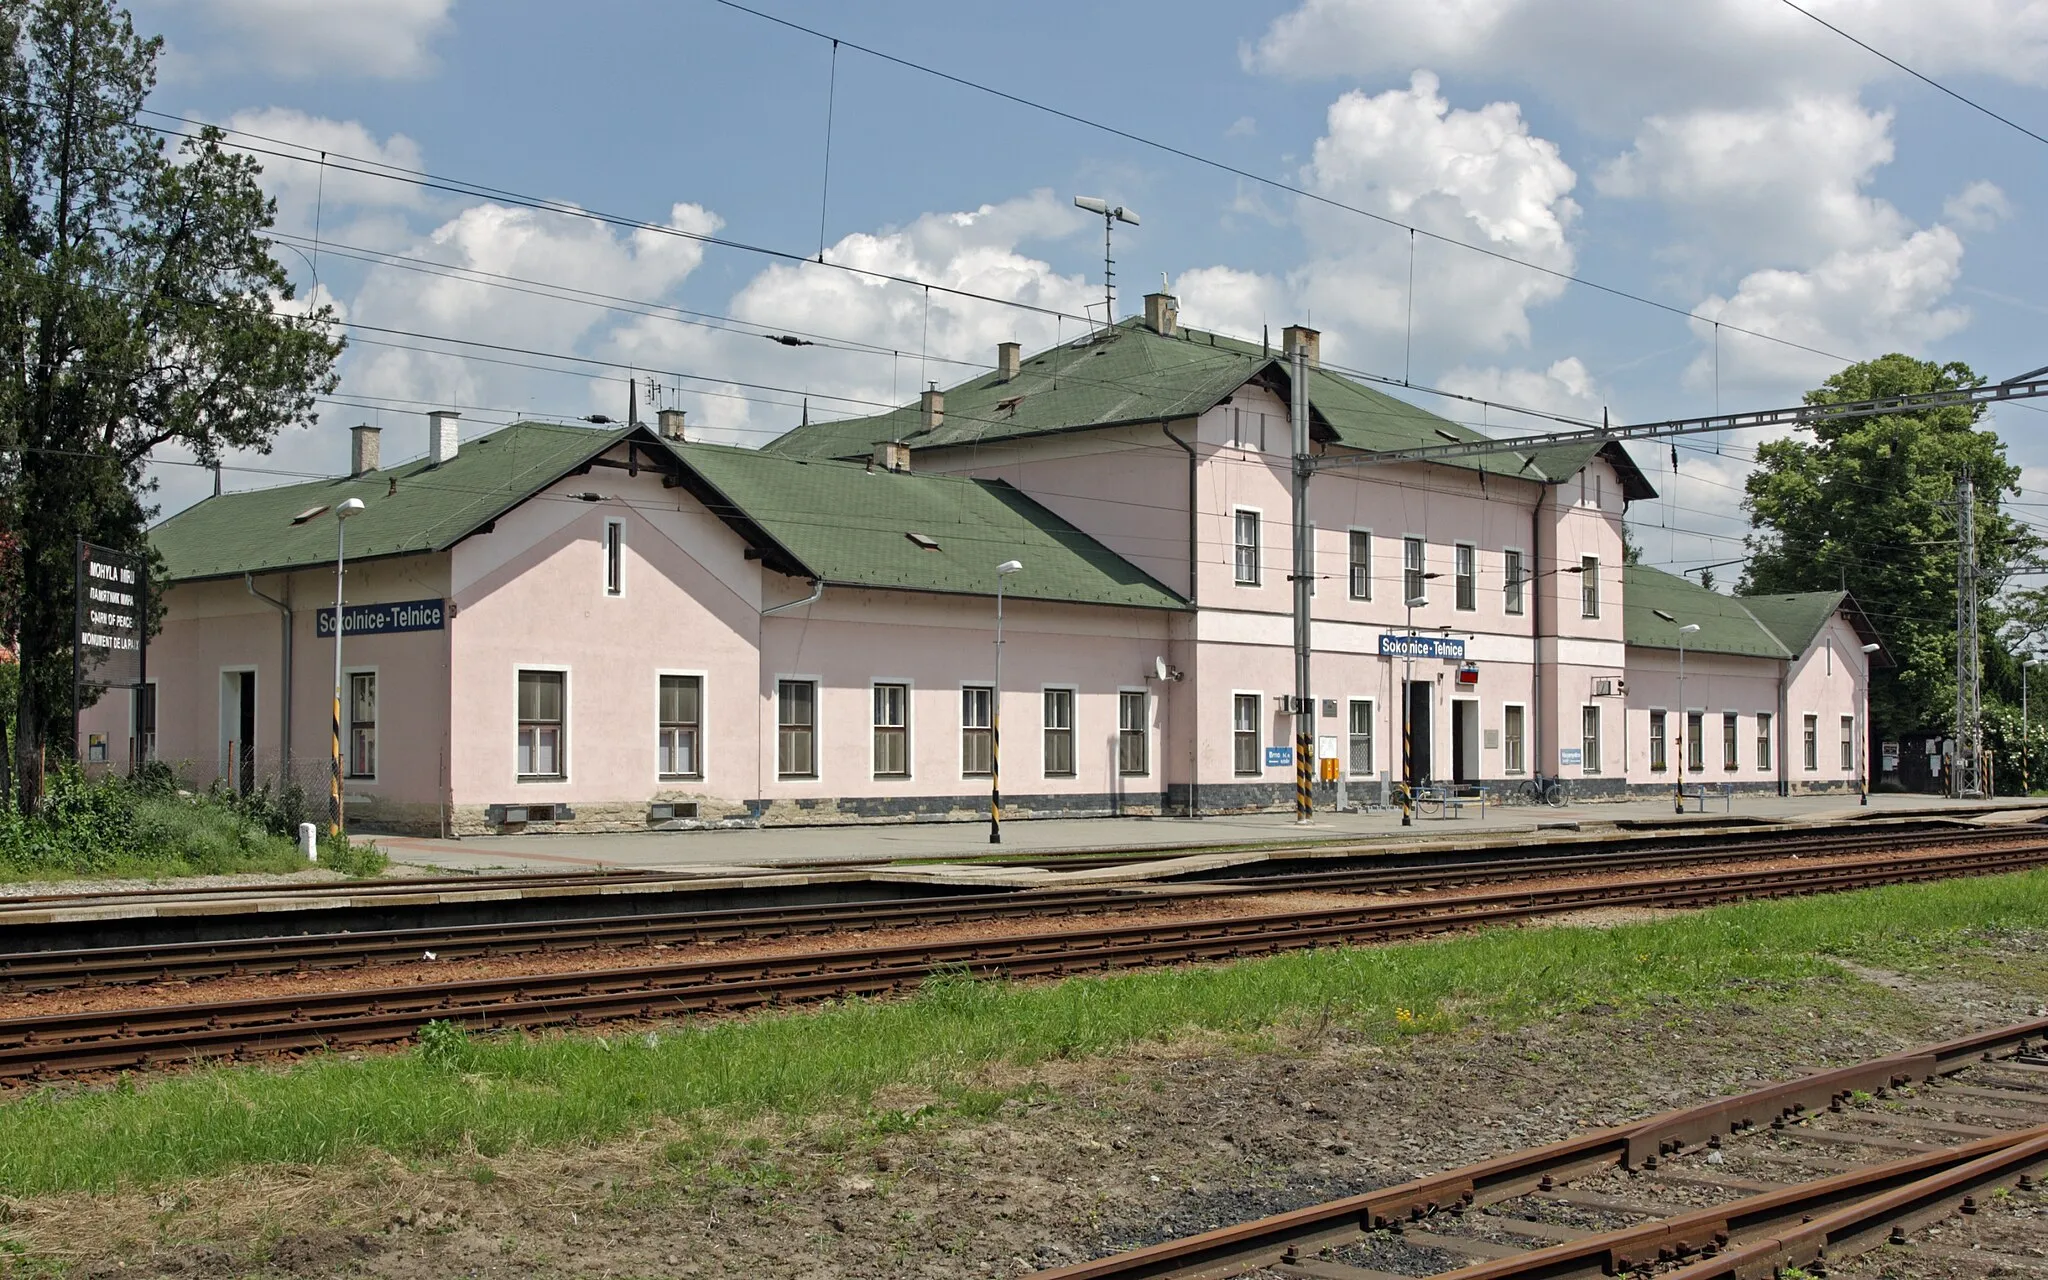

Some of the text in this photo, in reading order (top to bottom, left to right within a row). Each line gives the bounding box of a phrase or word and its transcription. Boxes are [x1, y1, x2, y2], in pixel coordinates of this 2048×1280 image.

[90, 561, 118, 582] MOHYLA
[90, 610, 133, 628] CAIRN OF PEACE
[81, 632, 113, 648] MONUMENT
[113, 637, 121, 649] DE
[121, 638, 127, 650] LA
[1382, 637, 1463, 657] Sokonice-Telnice
